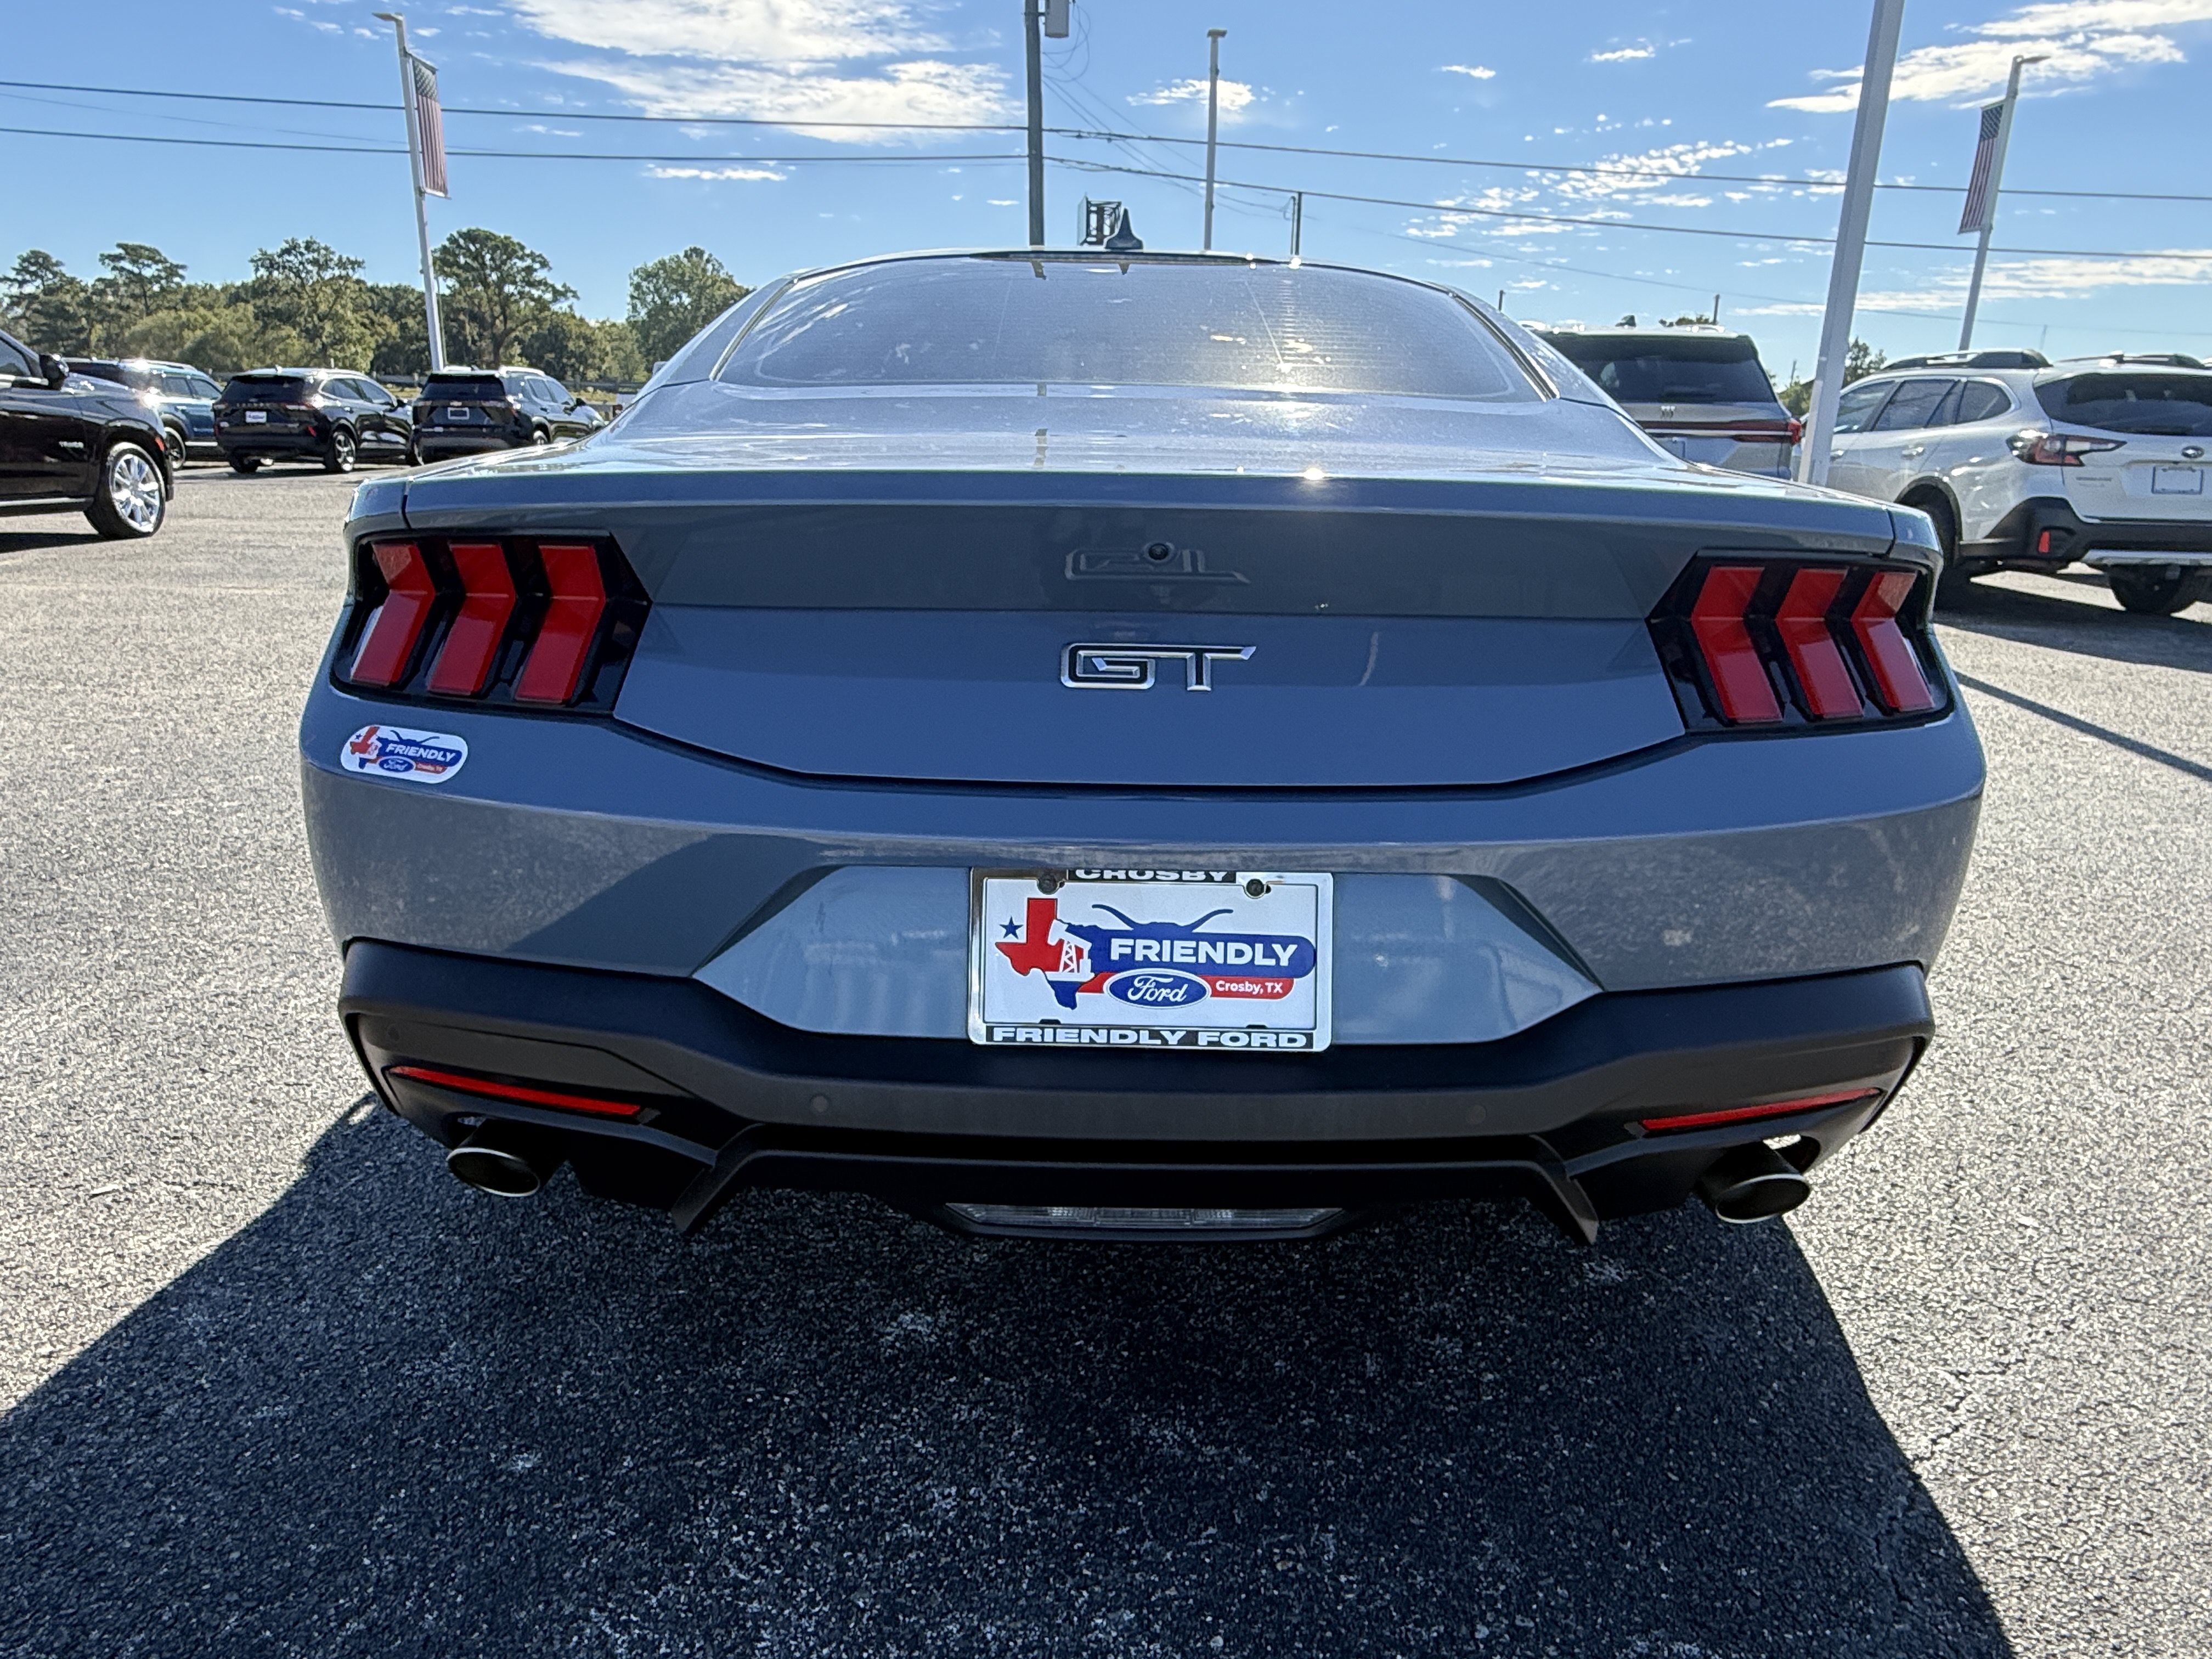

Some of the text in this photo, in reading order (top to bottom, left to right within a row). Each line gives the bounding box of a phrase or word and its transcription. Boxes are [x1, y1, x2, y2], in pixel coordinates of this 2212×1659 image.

[1060, 642, 1257, 692] GT
[385, 743, 456, 762] FRIENDLY
[1075, 869, 1228, 882] CROSBY
[1110, 938, 1299, 967] FRIENDLY
[1127, 975, 1189, 1003] Ford
[1215, 979, 1283, 995] Crosby, TX
[993, 1026, 1307, 1048] FRIENDLY FORD
